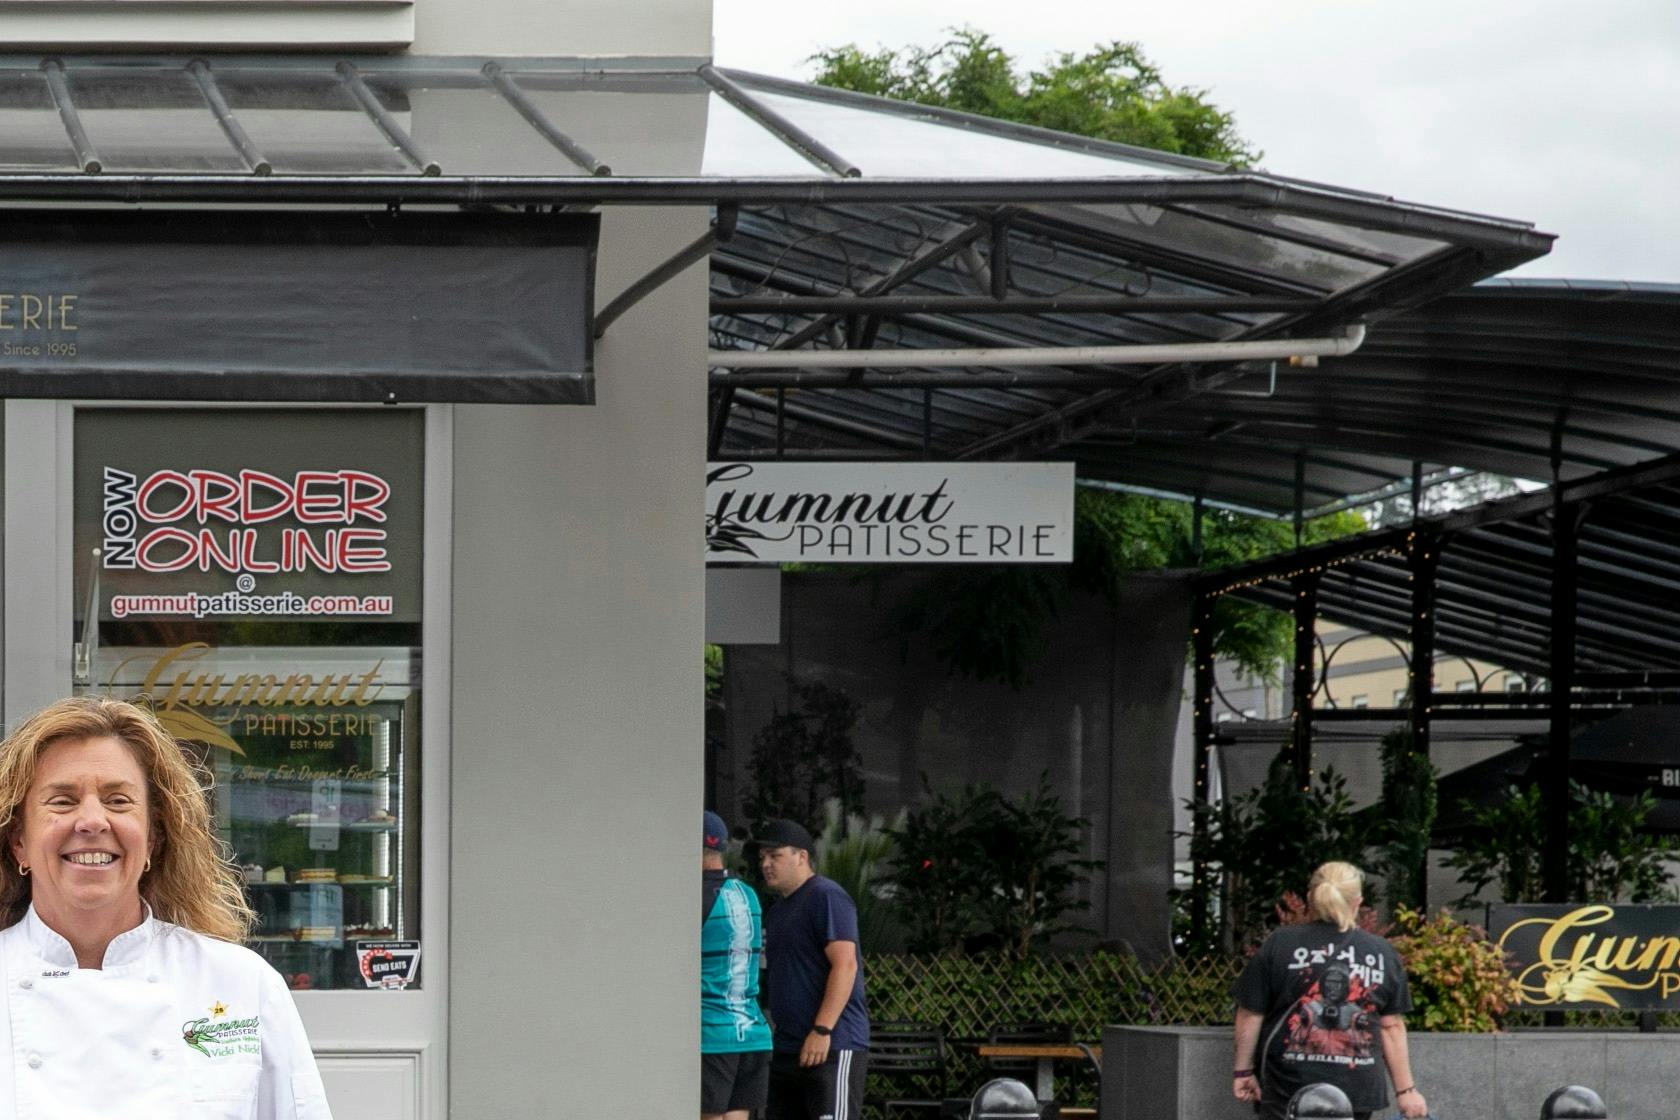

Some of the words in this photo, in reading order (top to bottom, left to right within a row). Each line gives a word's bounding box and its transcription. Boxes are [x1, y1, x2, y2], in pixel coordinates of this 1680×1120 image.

[3, 342, 40, 356] Since
[46, 343, 78, 357] 1995
[136, 469, 390, 524] ORDER
[104, 467, 137, 568] NOW
[135, 527, 391, 573] ONLINE
[797, 525, 1056, 556] PATISSERIE
[237, 574, 256, 593] @
[111, 592, 392, 618] gumnutpatisserie.com.au
[140, 642, 390, 707] Gumnut
[245, 713, 383, 736] PATISSERIE
[312, 740, 335, 750] 1995
[372, 962, 390, 973] SEND
[390, 960, 407, 972] EATS
[192, 1016, 260, 1034] Gumnut
[217, 1028, 258, 1038] PATISSERIE
